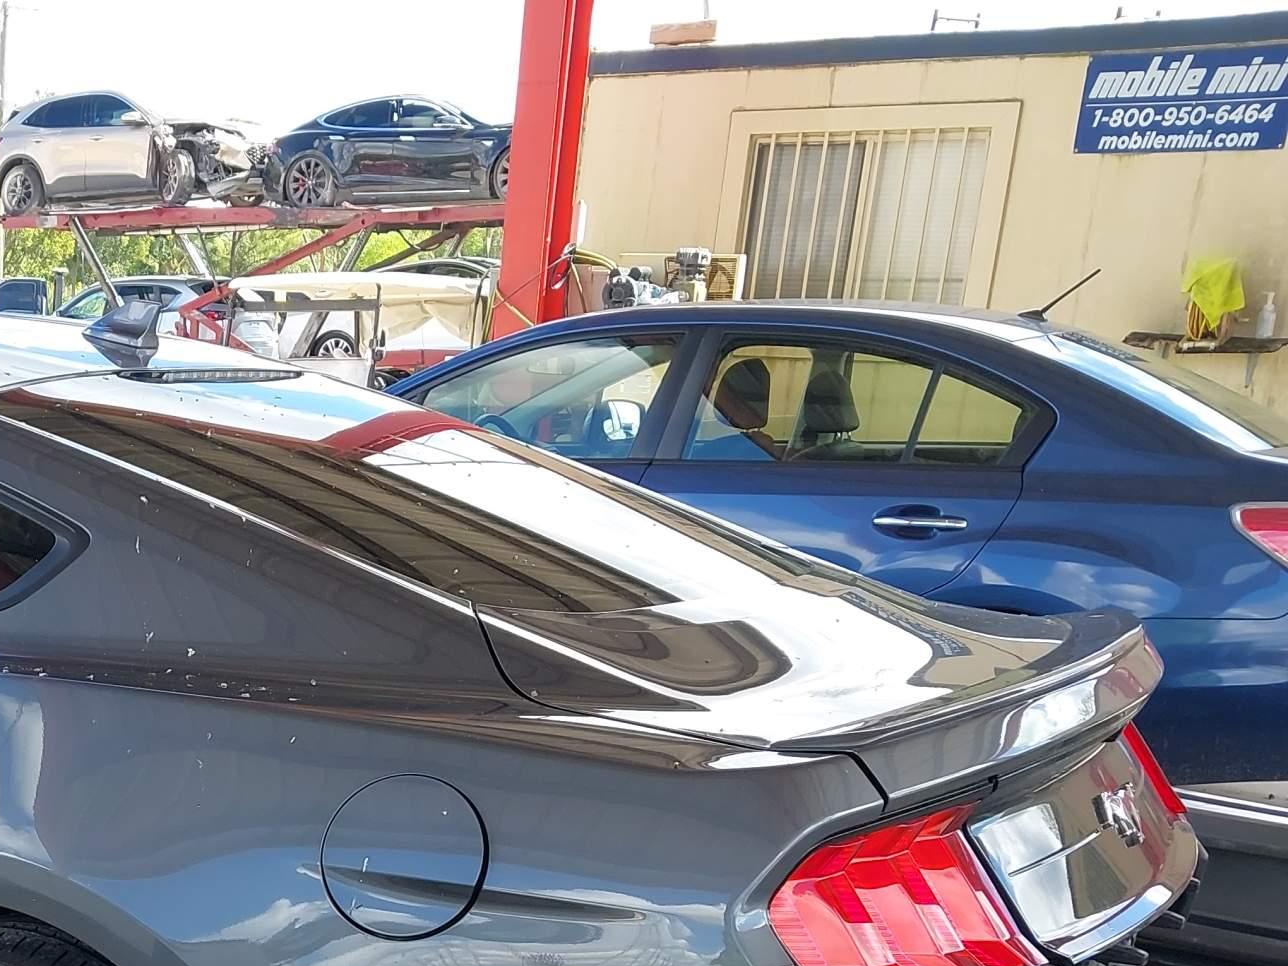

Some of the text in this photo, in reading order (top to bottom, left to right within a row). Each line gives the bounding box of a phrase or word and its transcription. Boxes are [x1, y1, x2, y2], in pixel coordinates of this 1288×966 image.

[1088, 54, 1207, 99] mobile
[1092, 103, 1277, 127] 1-800-950-6464
[1098, 129, 1260, 150] mobilemini.com
